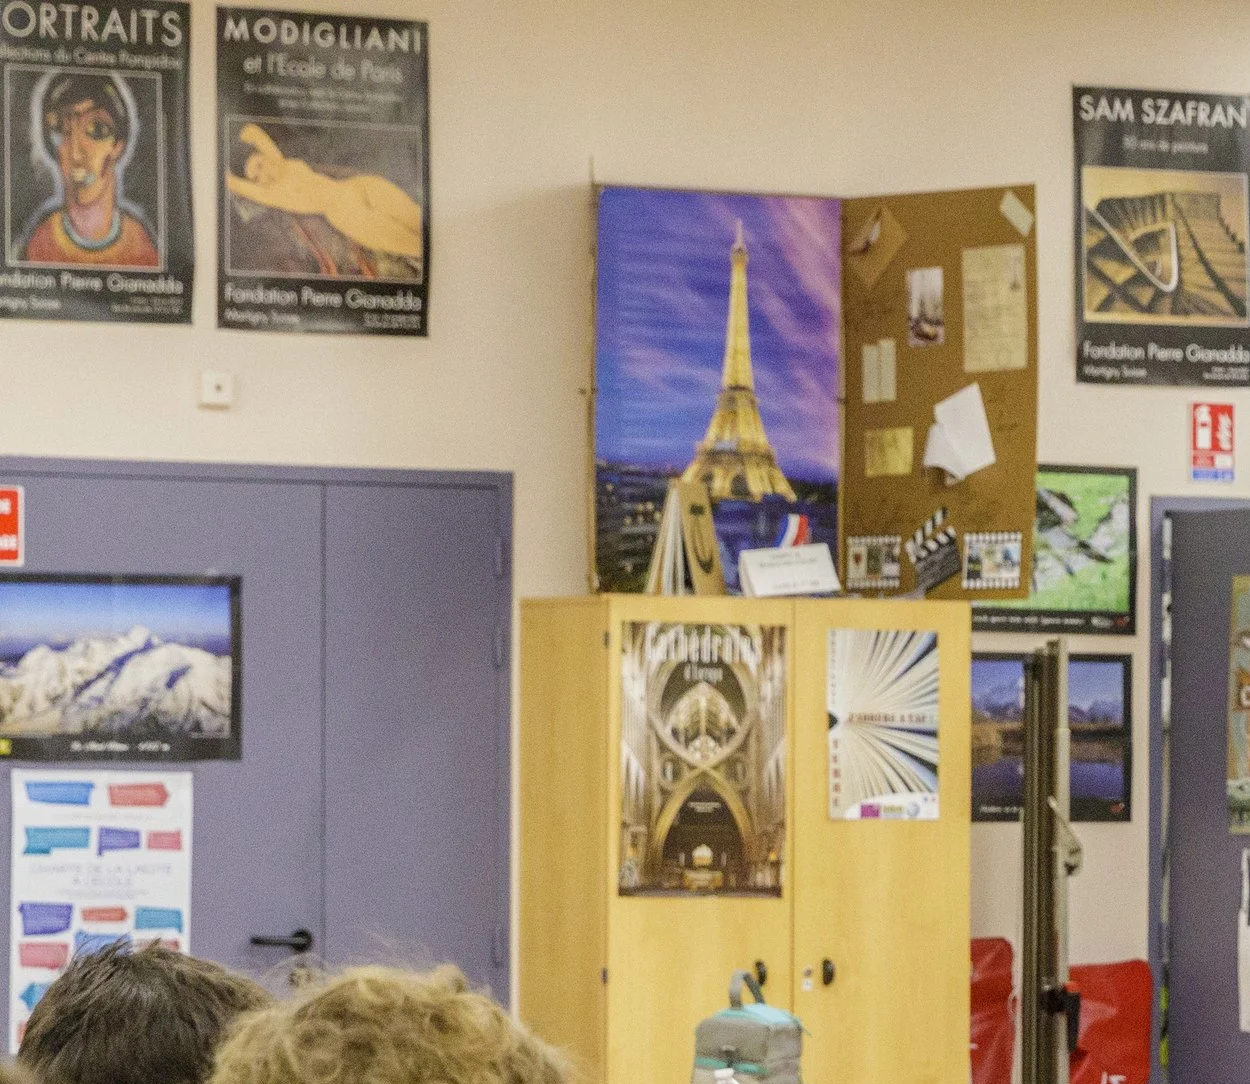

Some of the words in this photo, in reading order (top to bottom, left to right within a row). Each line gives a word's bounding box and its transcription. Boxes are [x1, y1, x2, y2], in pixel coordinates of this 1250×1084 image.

[223, 17, 421, 54] MODIGLIANI
[1079, 94, 1135, 123] SAM
[1141, 97, 1247, 128] SZAFRAN
[225, 281, 298, 306] Fondation
[1083, 340, 1146, 361] Fondation
